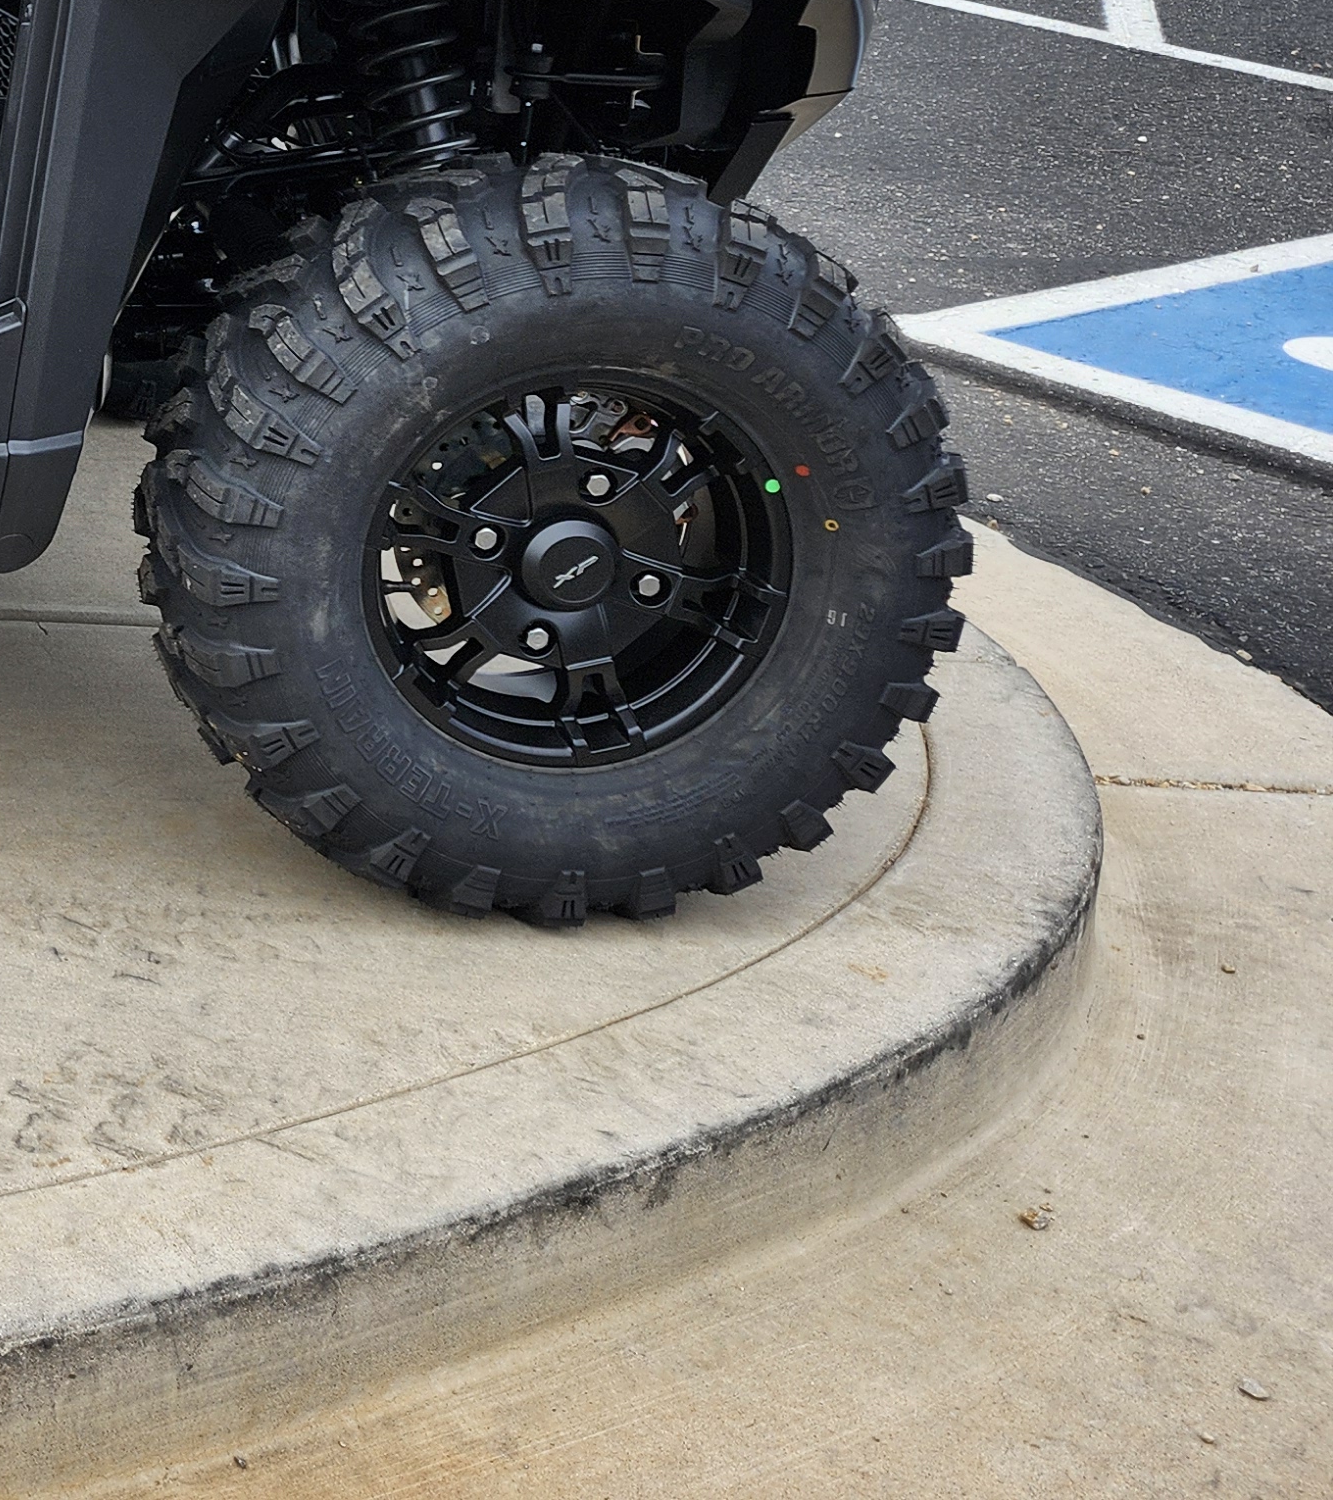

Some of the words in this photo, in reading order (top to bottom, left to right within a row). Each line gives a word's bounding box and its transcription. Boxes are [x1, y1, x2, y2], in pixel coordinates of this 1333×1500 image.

[674, 325, 757, 372] PRO
[750, 366, 860, 477] ARMOR
[553, 555, 600, 589] XP
[315, 656, 510, 841] X-TERRAIN
